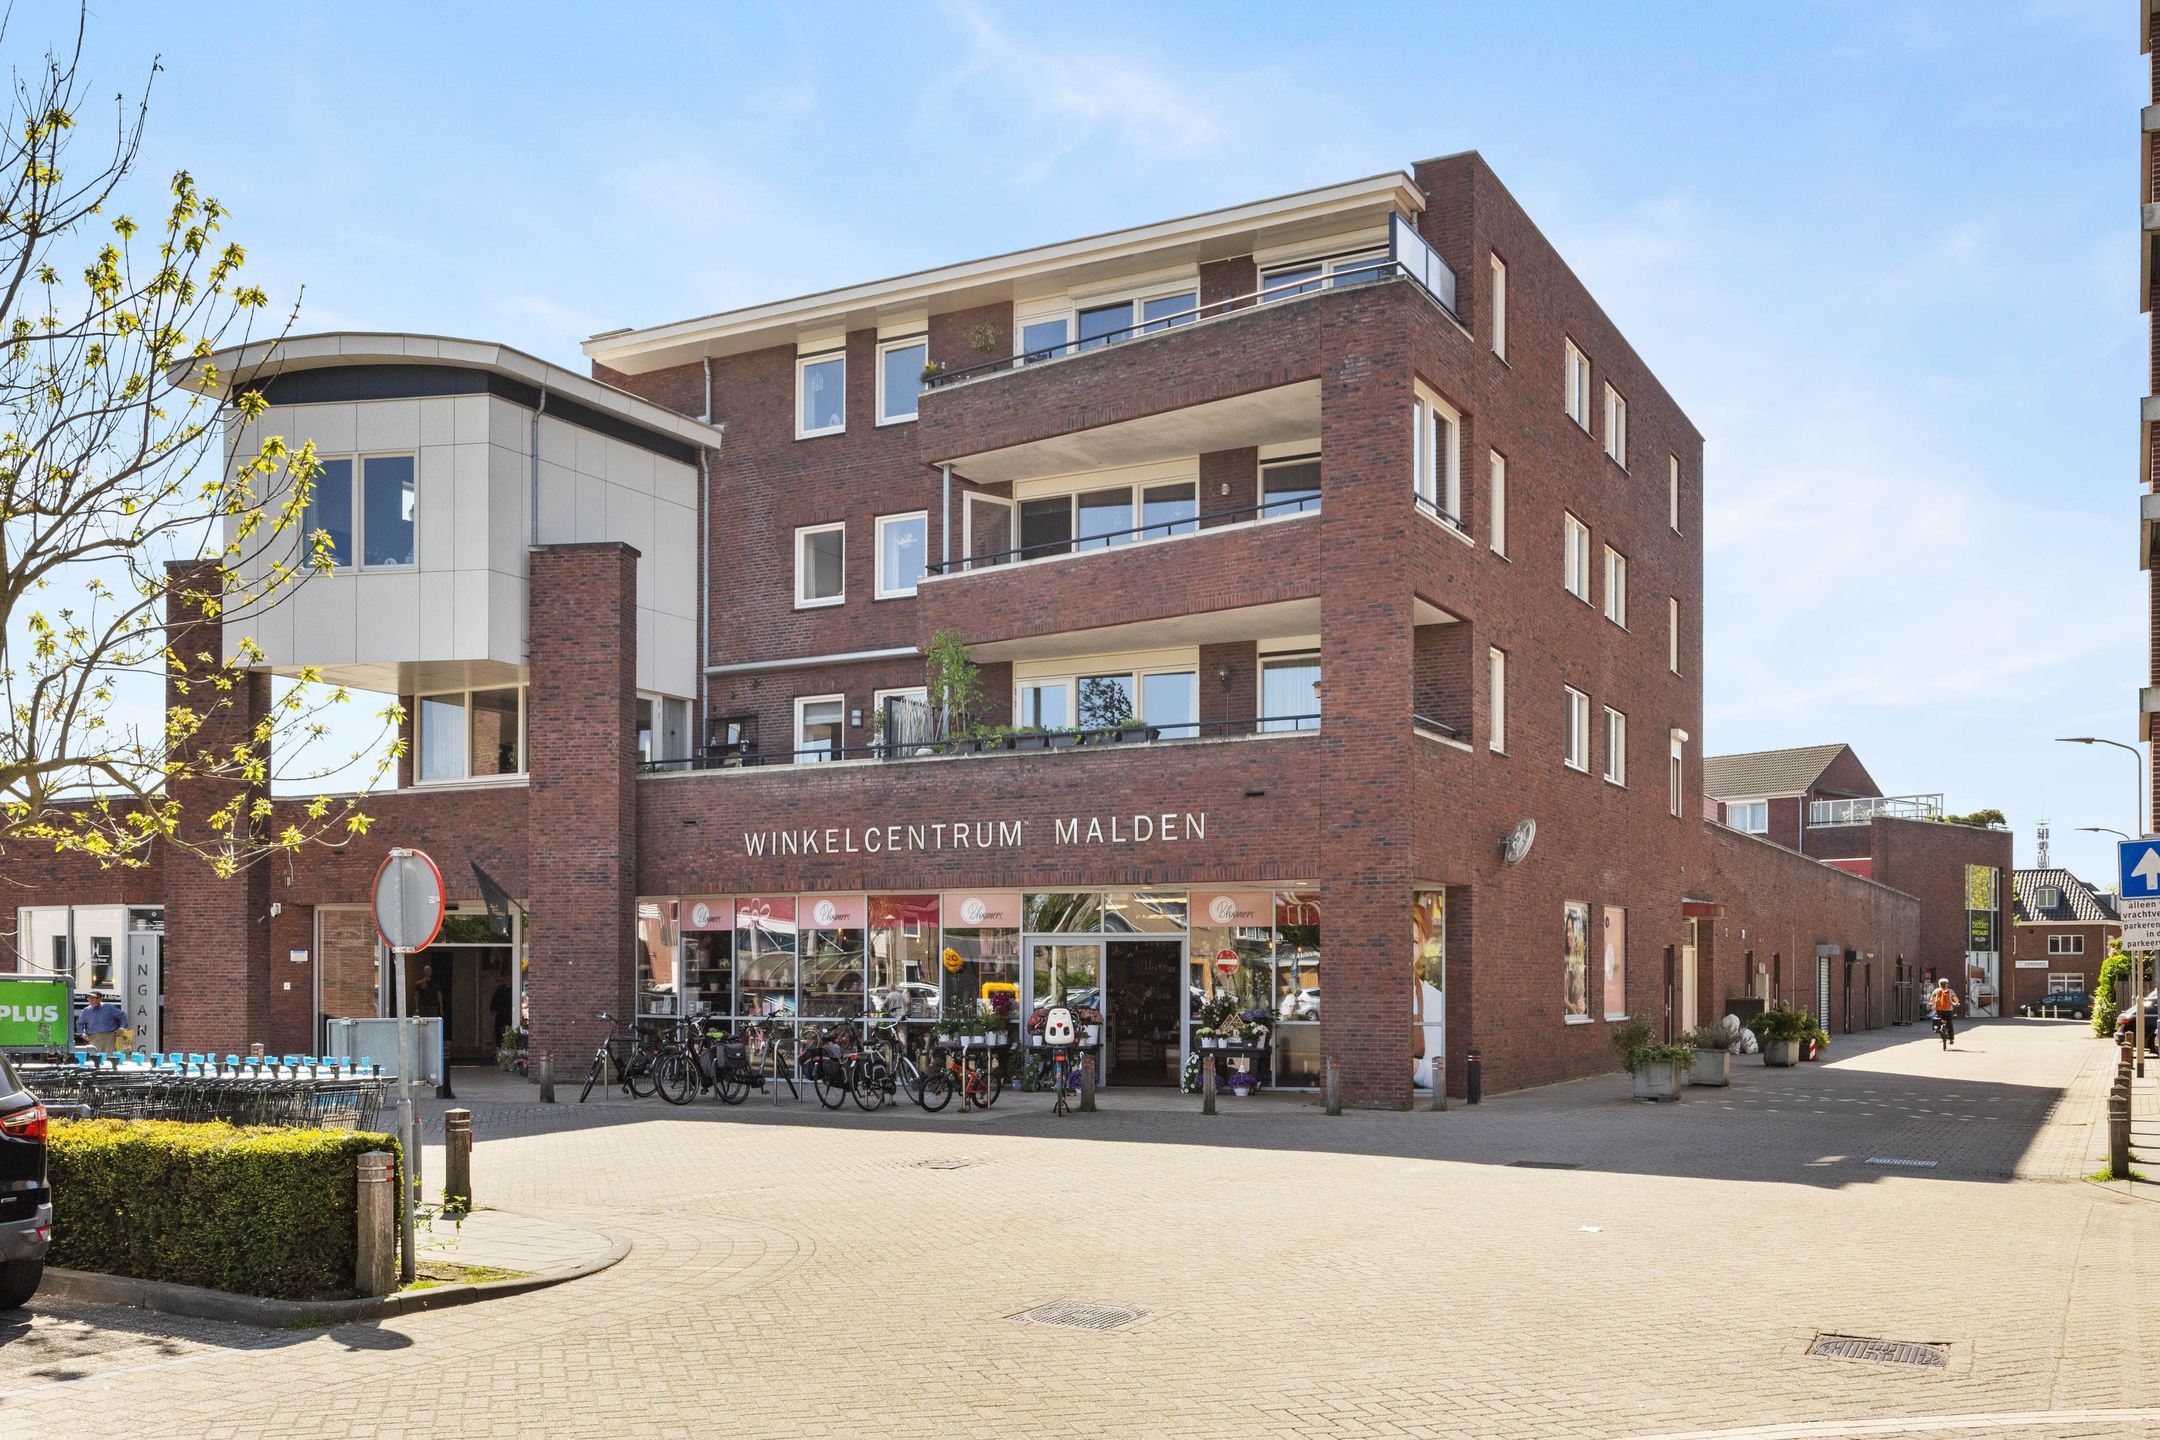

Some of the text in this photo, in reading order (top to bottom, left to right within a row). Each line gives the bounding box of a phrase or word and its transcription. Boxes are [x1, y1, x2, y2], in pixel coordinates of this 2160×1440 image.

[744, 812, 1206, 857] WINKELCENTRUM MALDEN
[2128, 901, 2156, 909] alleen
[2127, 940, 2160, 948] parkeer
[137, 945, 148, 1055] INGANG
[0, 1005, 59, 1022] PLUS
